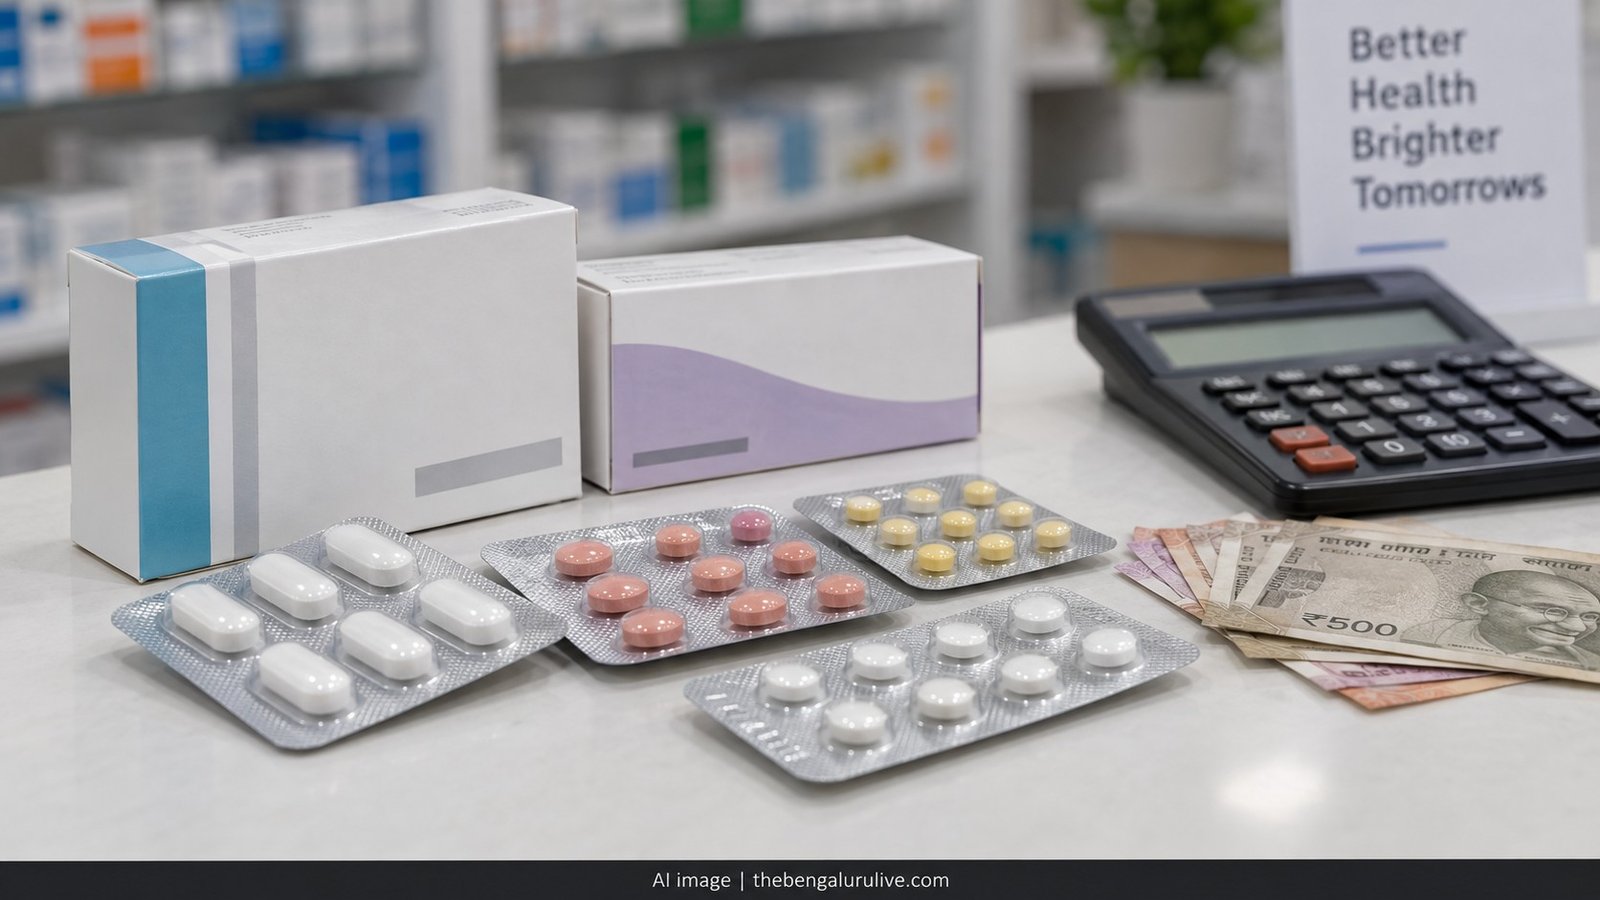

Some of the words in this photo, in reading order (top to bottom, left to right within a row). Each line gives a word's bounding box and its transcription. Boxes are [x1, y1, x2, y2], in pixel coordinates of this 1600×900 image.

[1349, 27, 1466, 62] Better
[1350, 71, 1477, 111] Health
[1351, 122, 1501, 166] Brighter
[1352, 174, 1547, 210] Tomorrows
[1384, 440, 1404, 453] 0
[1302, 612, 1398, 636] ₹500
